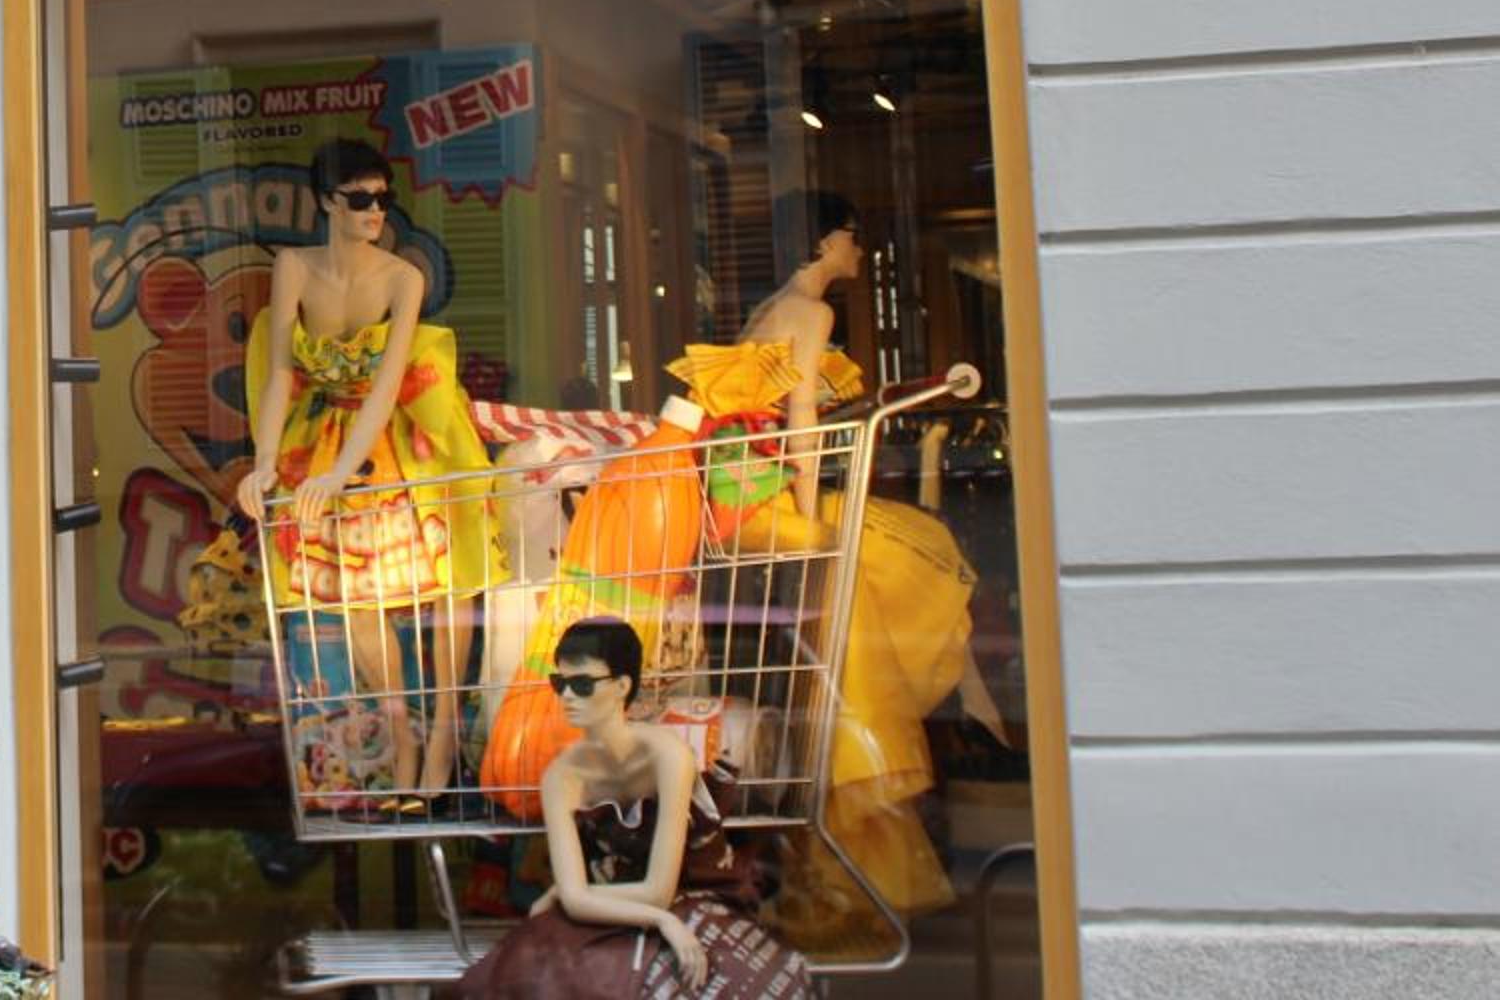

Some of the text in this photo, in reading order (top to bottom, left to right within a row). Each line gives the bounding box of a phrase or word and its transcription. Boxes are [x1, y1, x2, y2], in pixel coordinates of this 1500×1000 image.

[123, 83, 386, 125] MOSCHINO MIX FRUIT
[405, 61, 534, 147] NEW
[204, 124, 303, 142] FLAVORED
